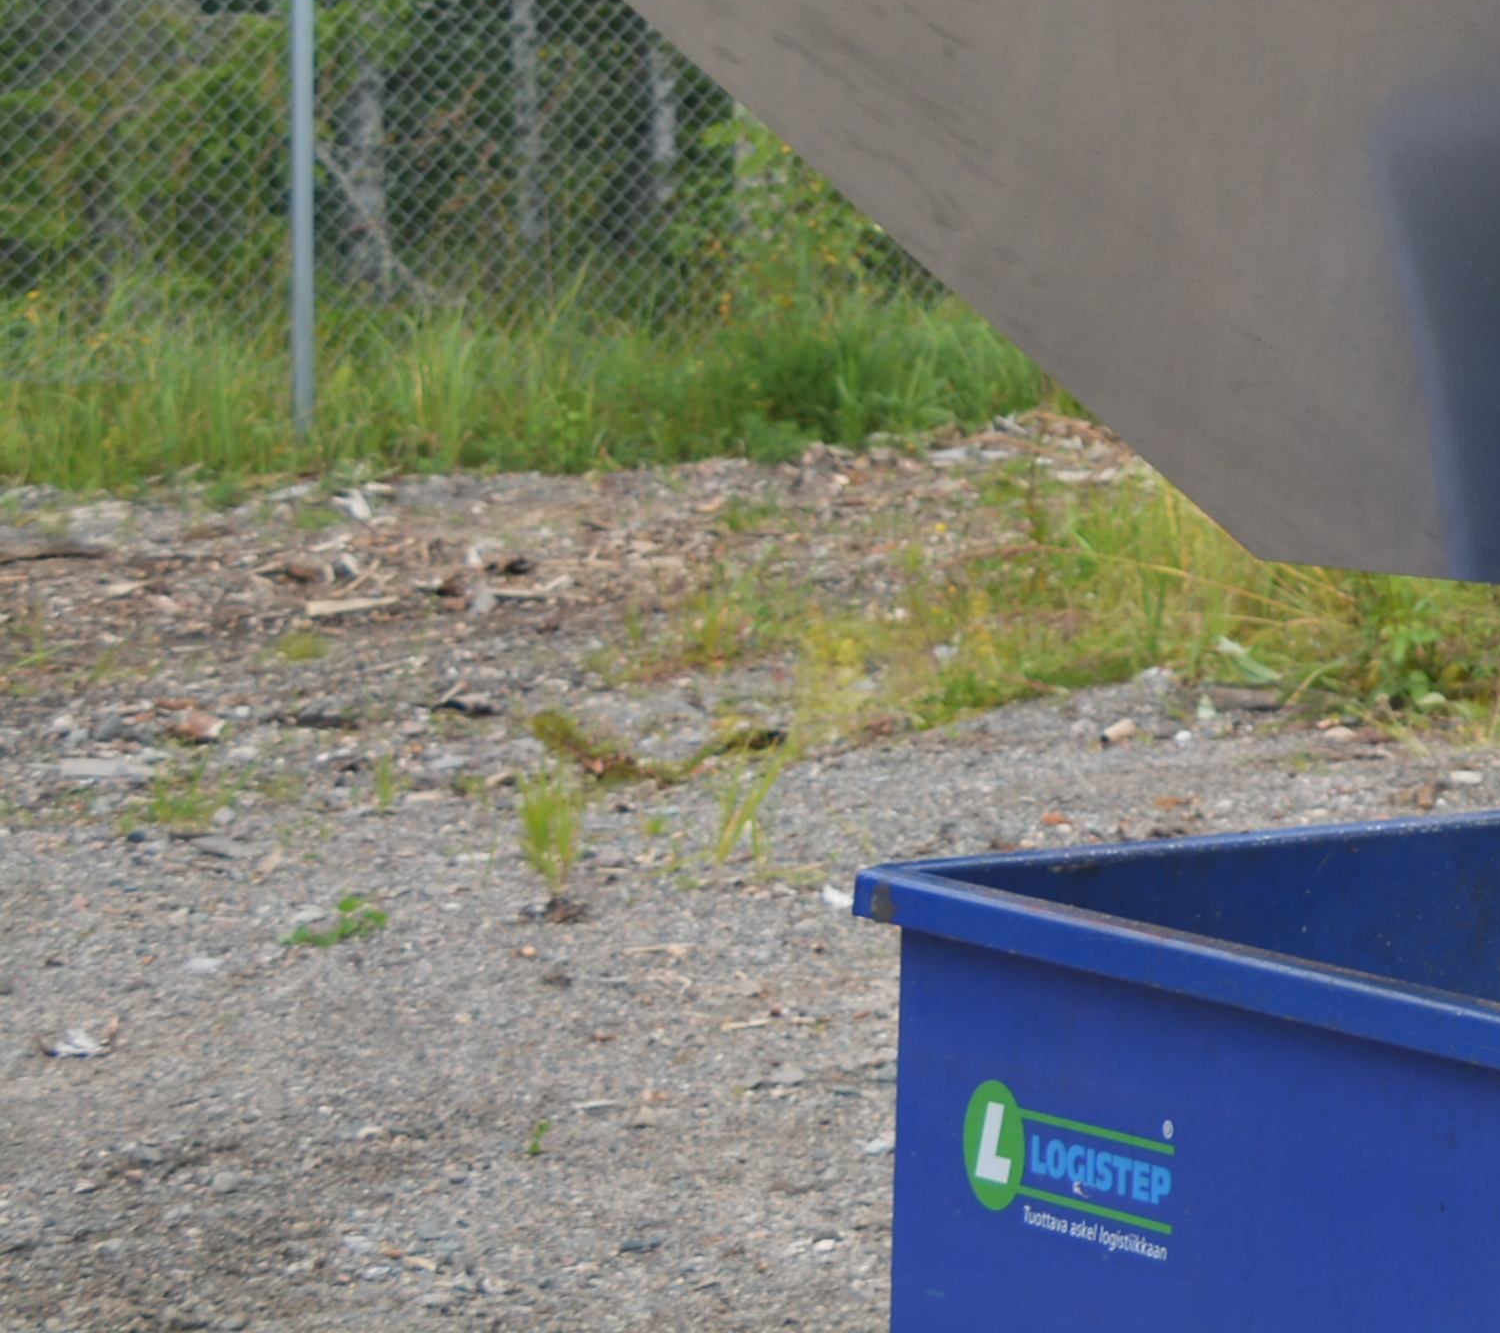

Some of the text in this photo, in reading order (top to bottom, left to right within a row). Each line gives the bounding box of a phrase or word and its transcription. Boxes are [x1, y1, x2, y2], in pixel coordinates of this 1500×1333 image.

[1031, 1134, 1172, 1204] LOGISTEP
[1023, 1205, 1167, 1261] Tuottava askel logistiikkaan
